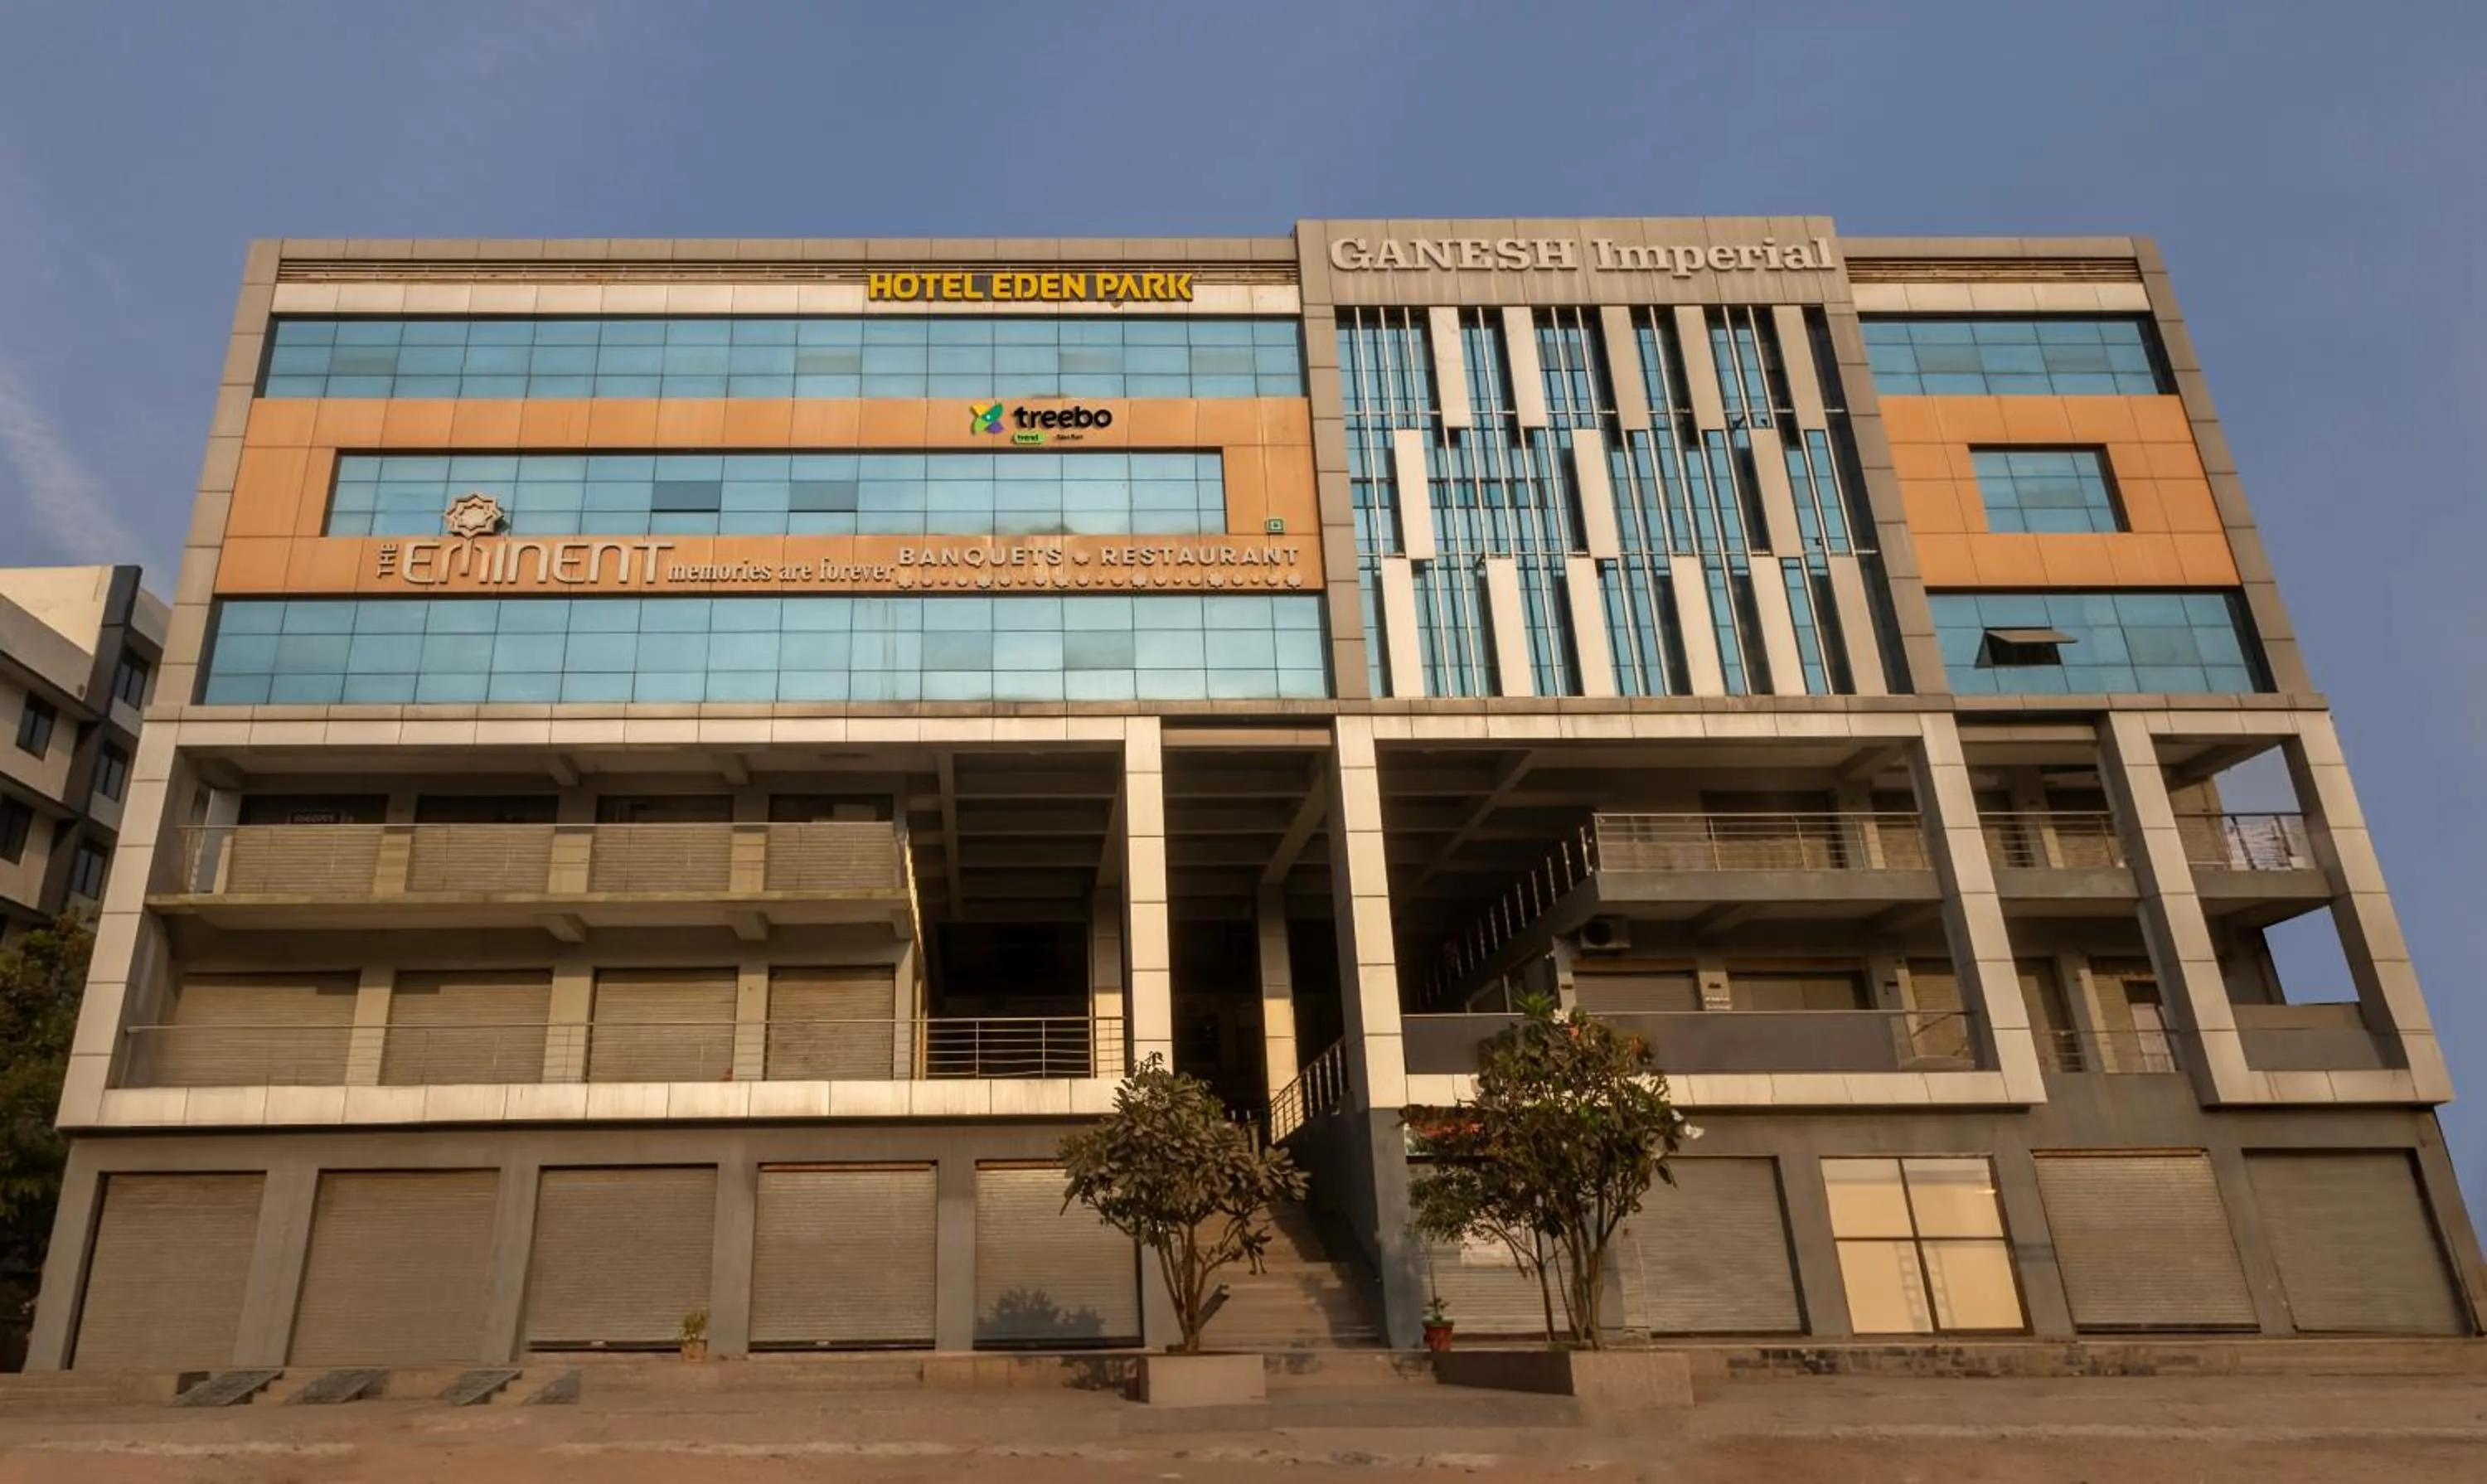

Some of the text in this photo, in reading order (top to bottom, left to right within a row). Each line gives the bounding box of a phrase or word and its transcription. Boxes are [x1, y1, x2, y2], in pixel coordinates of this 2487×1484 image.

[1330, 235, 1836, 279] GANESH Imperial
[868, 272, 1193, 301] HOTEL EDEN PARK
[1012, 405, 1113, 429] treebo
[376, 543, 398, 579] THE
[667, 557, 896, 583] memories are forever
[898, 546, 1299, 567] BANQUETS RESTAURANT
